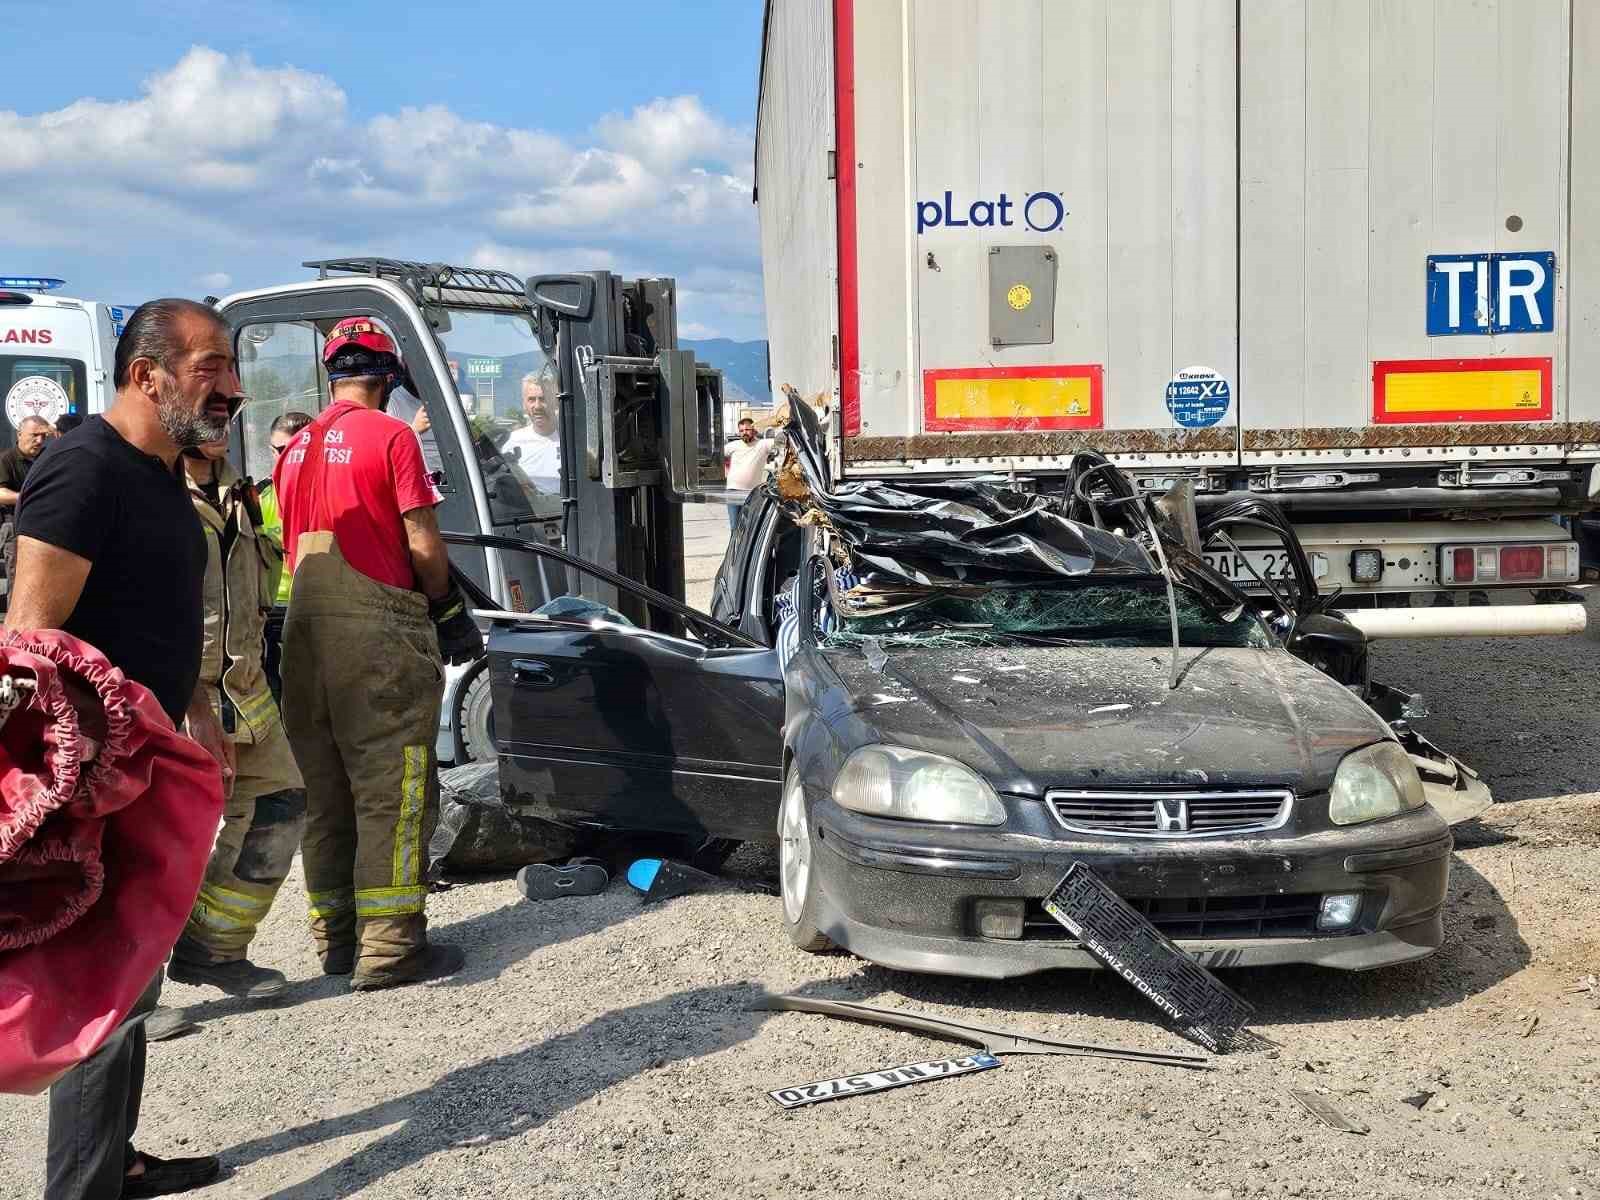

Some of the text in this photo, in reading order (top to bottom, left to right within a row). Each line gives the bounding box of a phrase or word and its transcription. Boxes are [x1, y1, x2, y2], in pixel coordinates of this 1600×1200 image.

[1434, 259, 1546, 328] TIR
[1199, 381, 1228, 401] XL
[877, 1065, 927, 1084] NA
[778, 1076, 872, 1103] 5720
